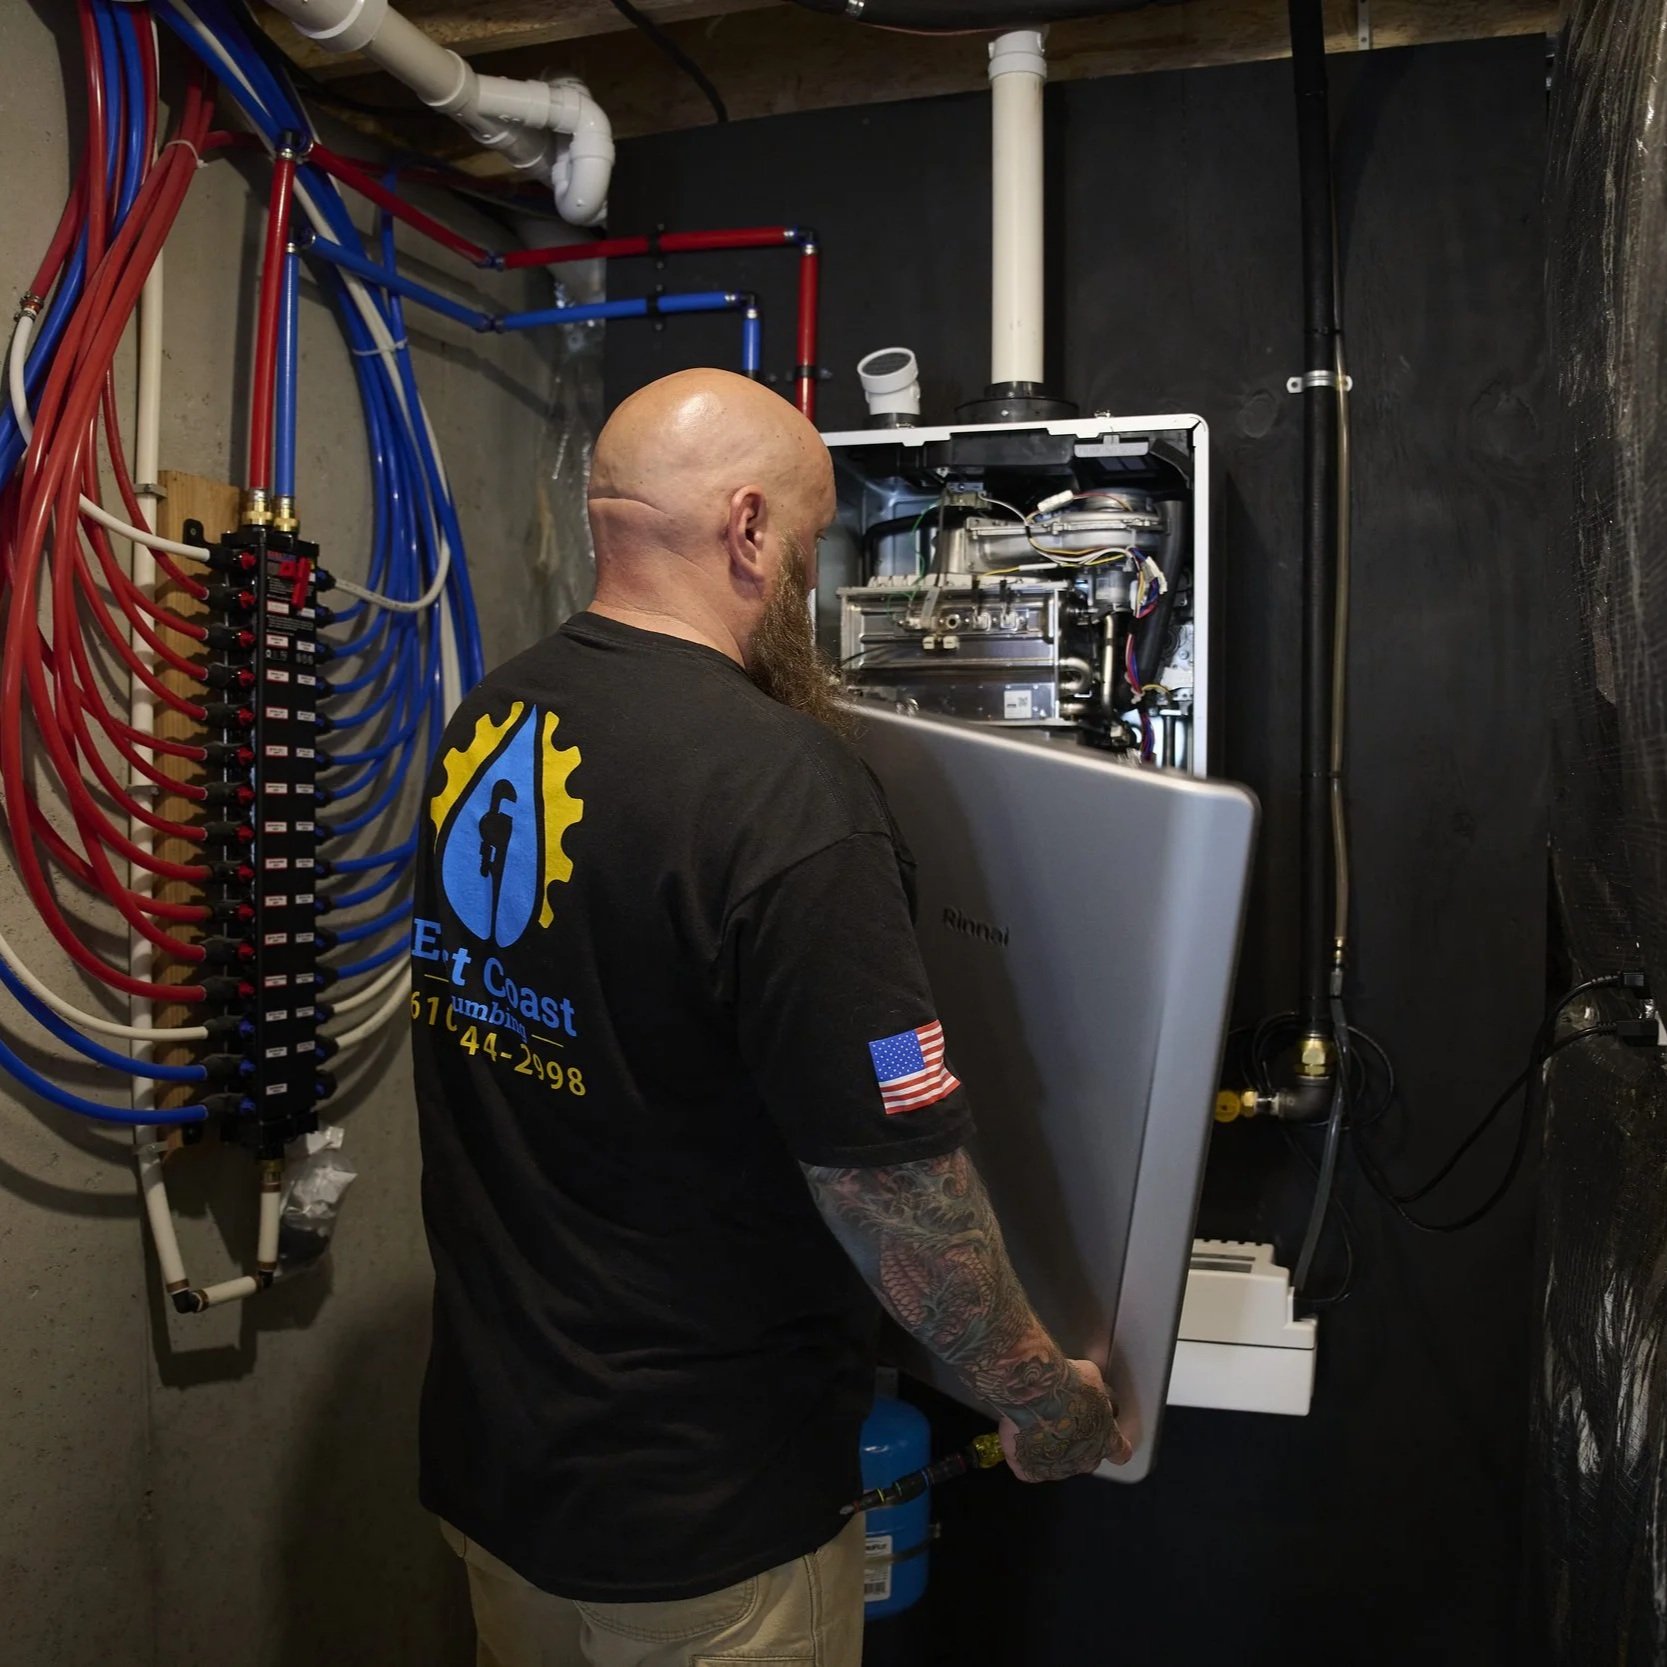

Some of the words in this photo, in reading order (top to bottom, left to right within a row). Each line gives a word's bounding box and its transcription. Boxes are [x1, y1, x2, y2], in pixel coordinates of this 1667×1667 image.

[943, 907, 1009, 946] Rinnai
[411, 918, 471, 986] Et
[483, 957, 577, 1037] Coast
[451, 995, 528, 1044] umbing
